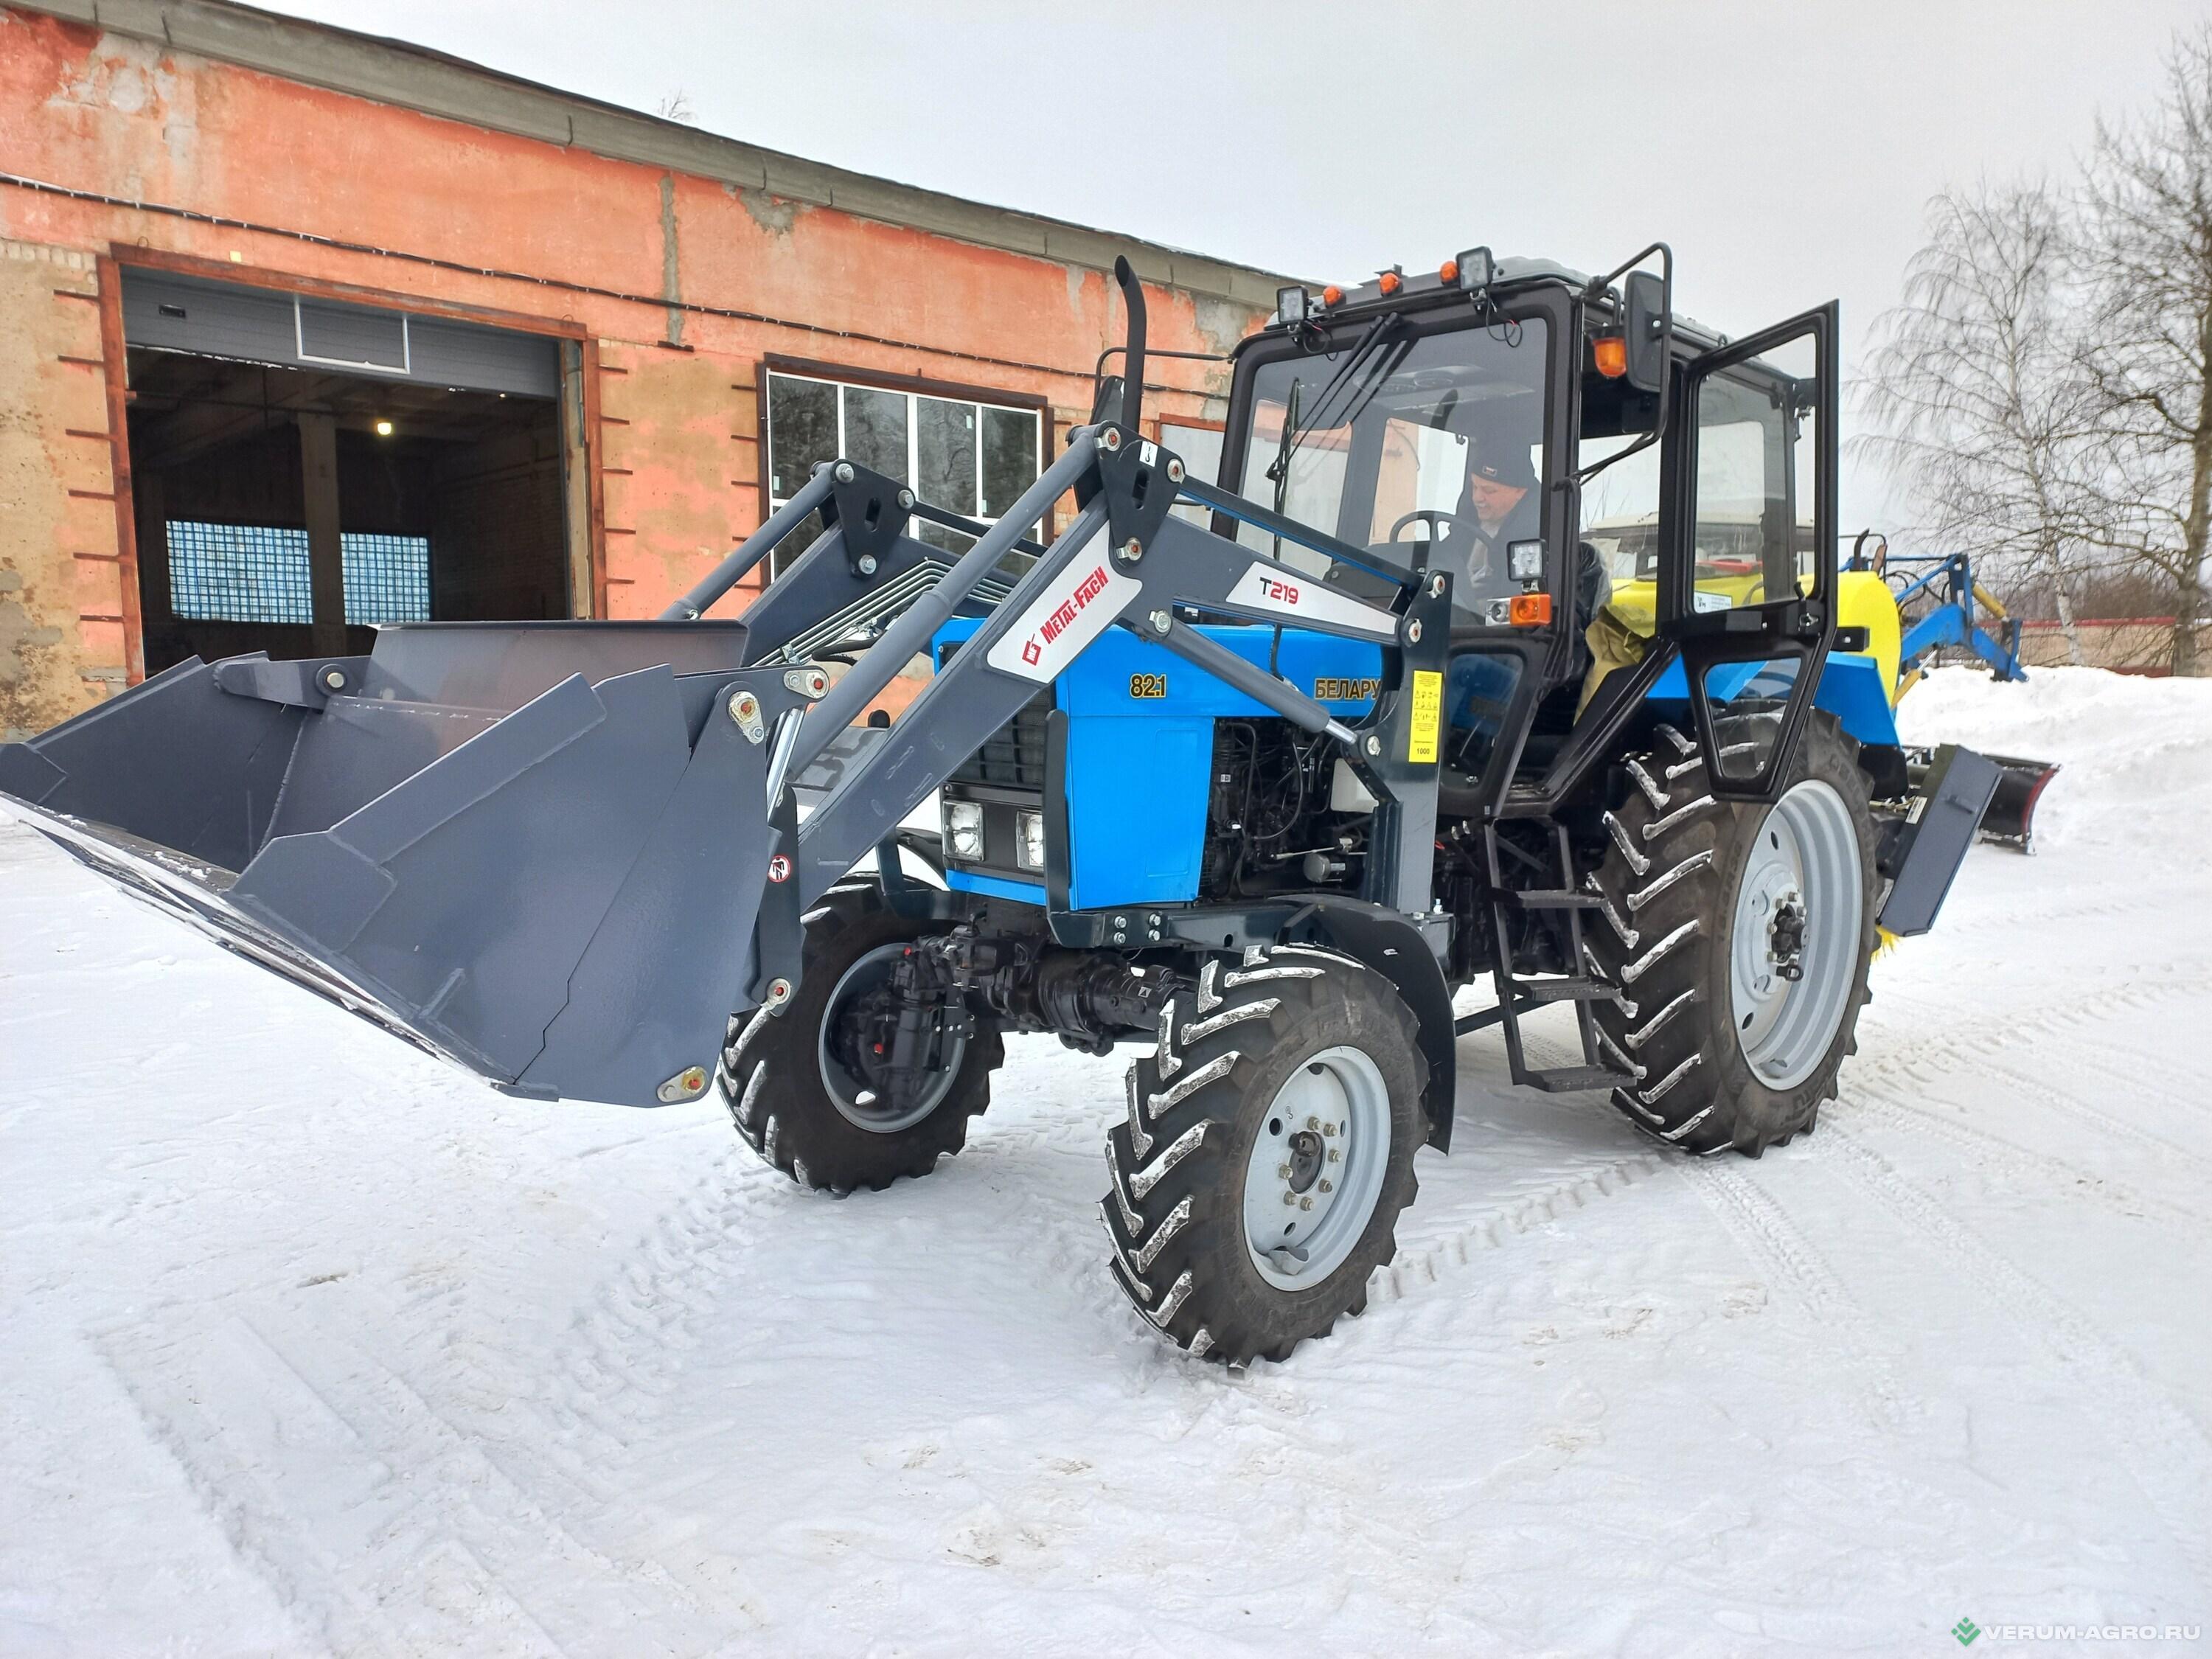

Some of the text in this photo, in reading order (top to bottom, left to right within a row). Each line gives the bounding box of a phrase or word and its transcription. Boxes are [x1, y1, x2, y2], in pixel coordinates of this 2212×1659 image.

[1040, 566, 1109, 644] METAL-FACH
[1259, 577, 1298, 605] T219
[1130, 673, 1166, 698] 82.1
